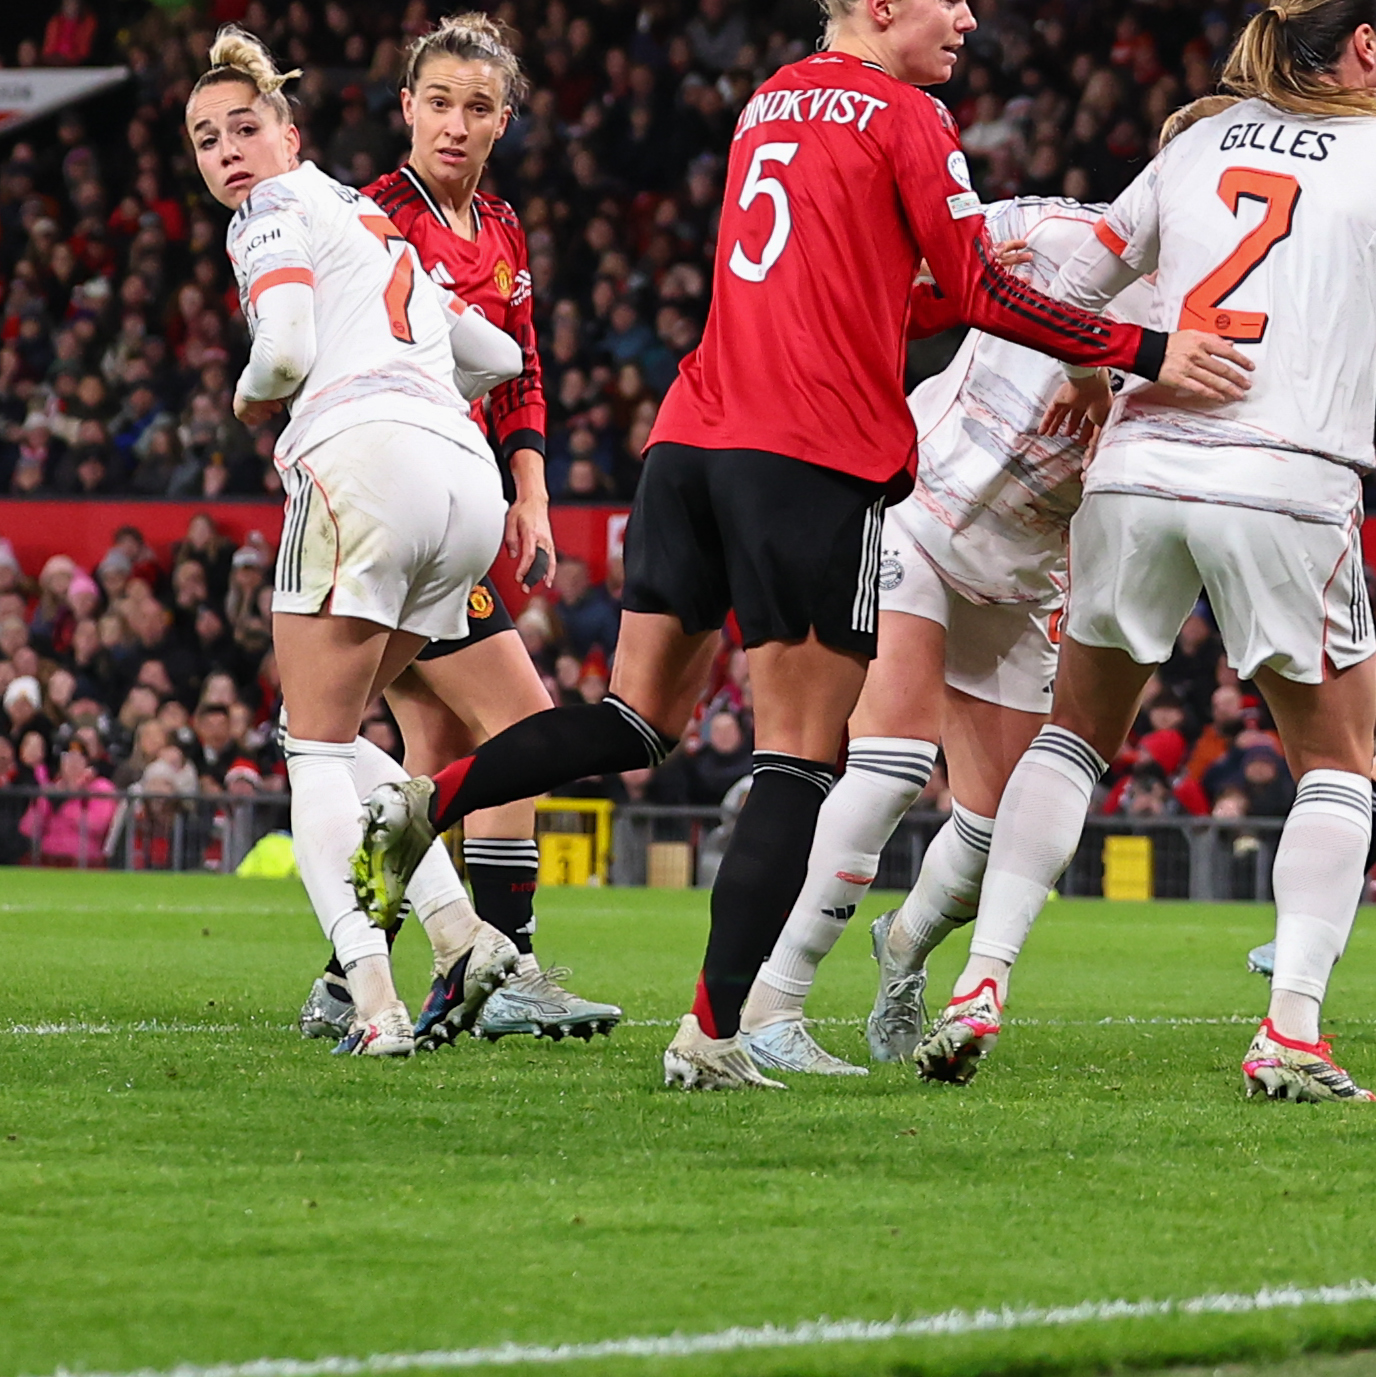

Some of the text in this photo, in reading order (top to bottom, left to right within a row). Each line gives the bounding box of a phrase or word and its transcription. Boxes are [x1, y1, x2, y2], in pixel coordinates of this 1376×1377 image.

[1220, 123, 1336, 162] GILLES
[358, 214, 416, 345] 7
[728, 141, 800, 284] 5
[1178, 166, 1303, 344] 2
